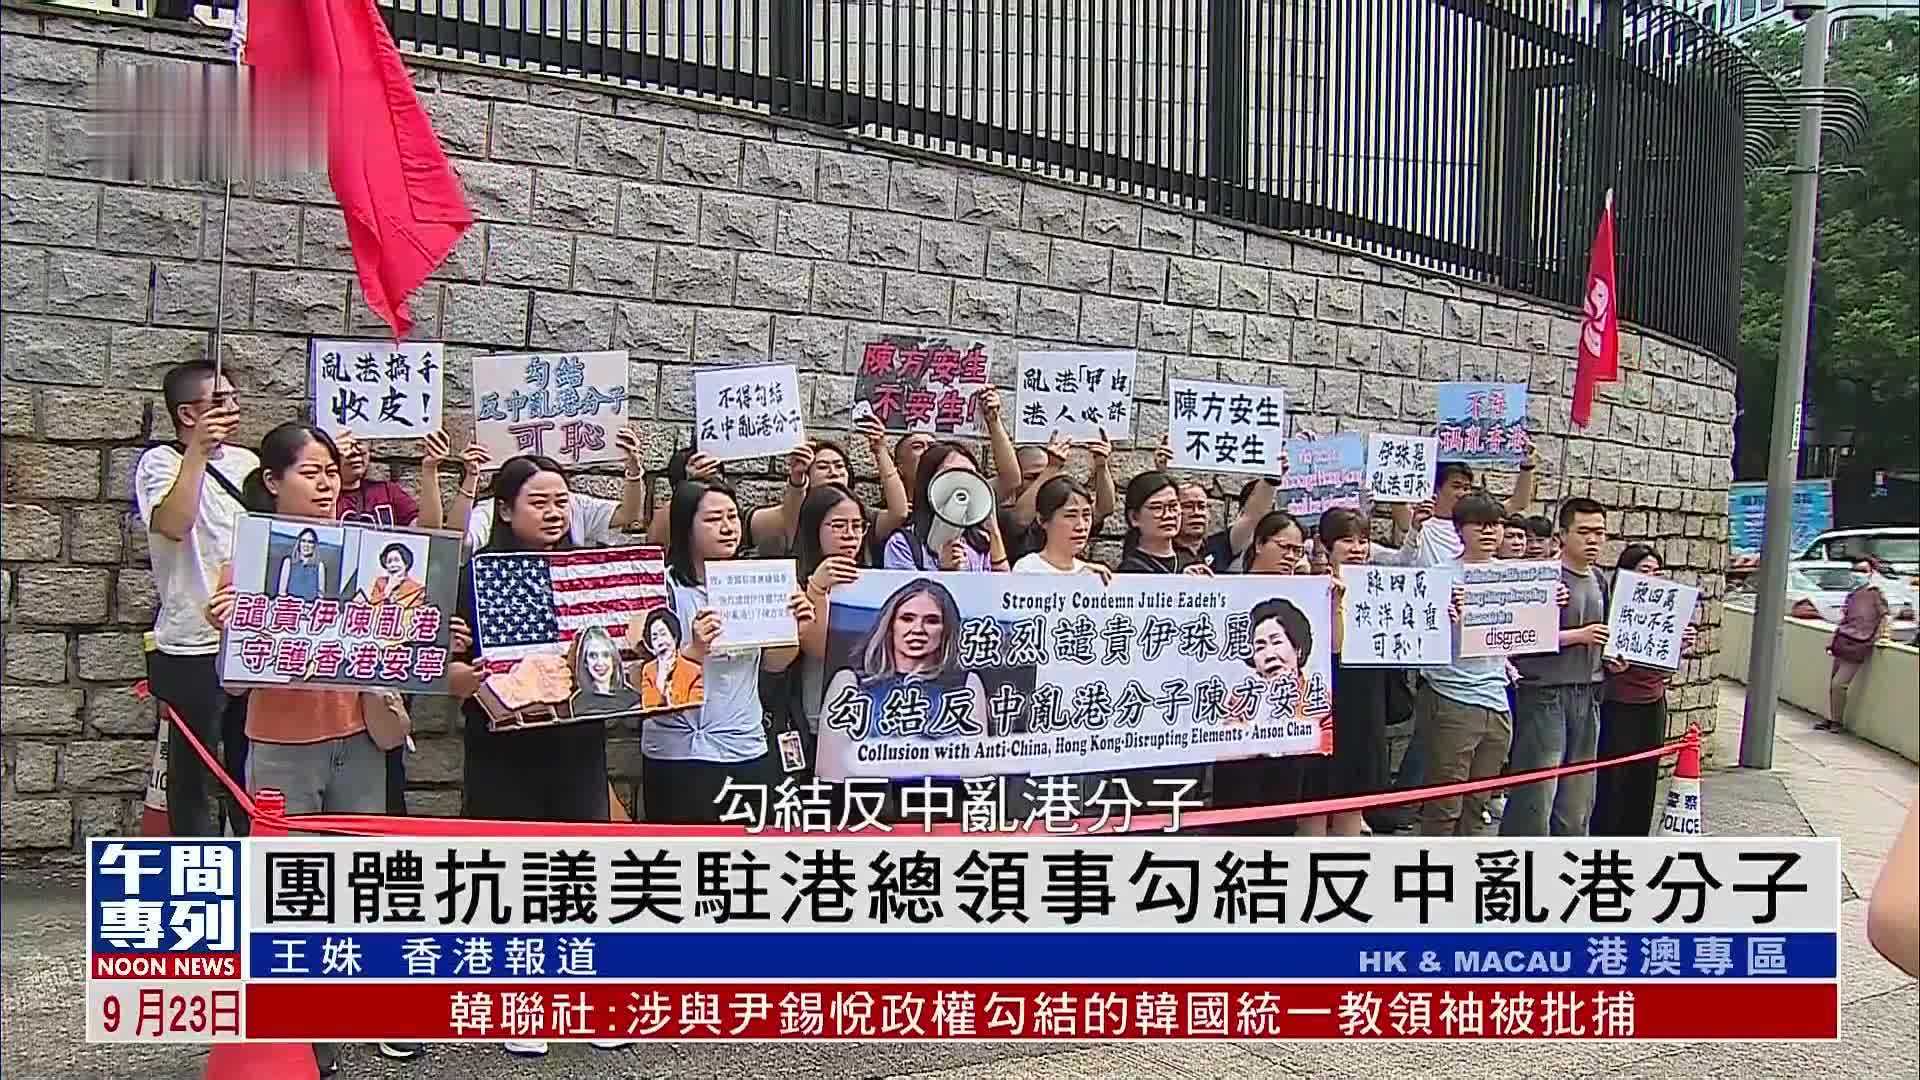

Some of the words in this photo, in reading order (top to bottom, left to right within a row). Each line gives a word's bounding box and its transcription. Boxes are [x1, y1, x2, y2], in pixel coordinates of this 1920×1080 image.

[321, 352, 439, 384] 亂港搞手
[861, 341, 988, 384] 陳方安生
[1174, 388, 1281, 427] 陳方安生
[508, 422, 606, 462] 可恥
[1185, 430, 1266, 465] 不安生
[231, 592, 442, 643] 譴責伊陳亂港
[1002, 591, 1066, 613] Strongly
[1072, 591, 1134, 610] Condemn
[1137, 591, 1173, 610] Julie
[1177, 591, 1228, 609] Eadeh's
[959, 612, 1254, 666] 強烈譴責伊珠麗
[1485, 626, 1537, 650] disgrace
[240, 636, 447, 682] 守護香港安寧
[826, 673, 1332, 740] 勾結反中亂港分子陳方安生
[857, 743, 930, 763] Collusion
[935, 742, 969, 762] with
[1054, 738, 1086, 756] Hong
[1191, 728, 1242, 746] Elements
[1252, 727, 1285, 740] Anson
[1286, 721, 1313, 737] Chan
[1659, 813, 1700, 834] OLICE
